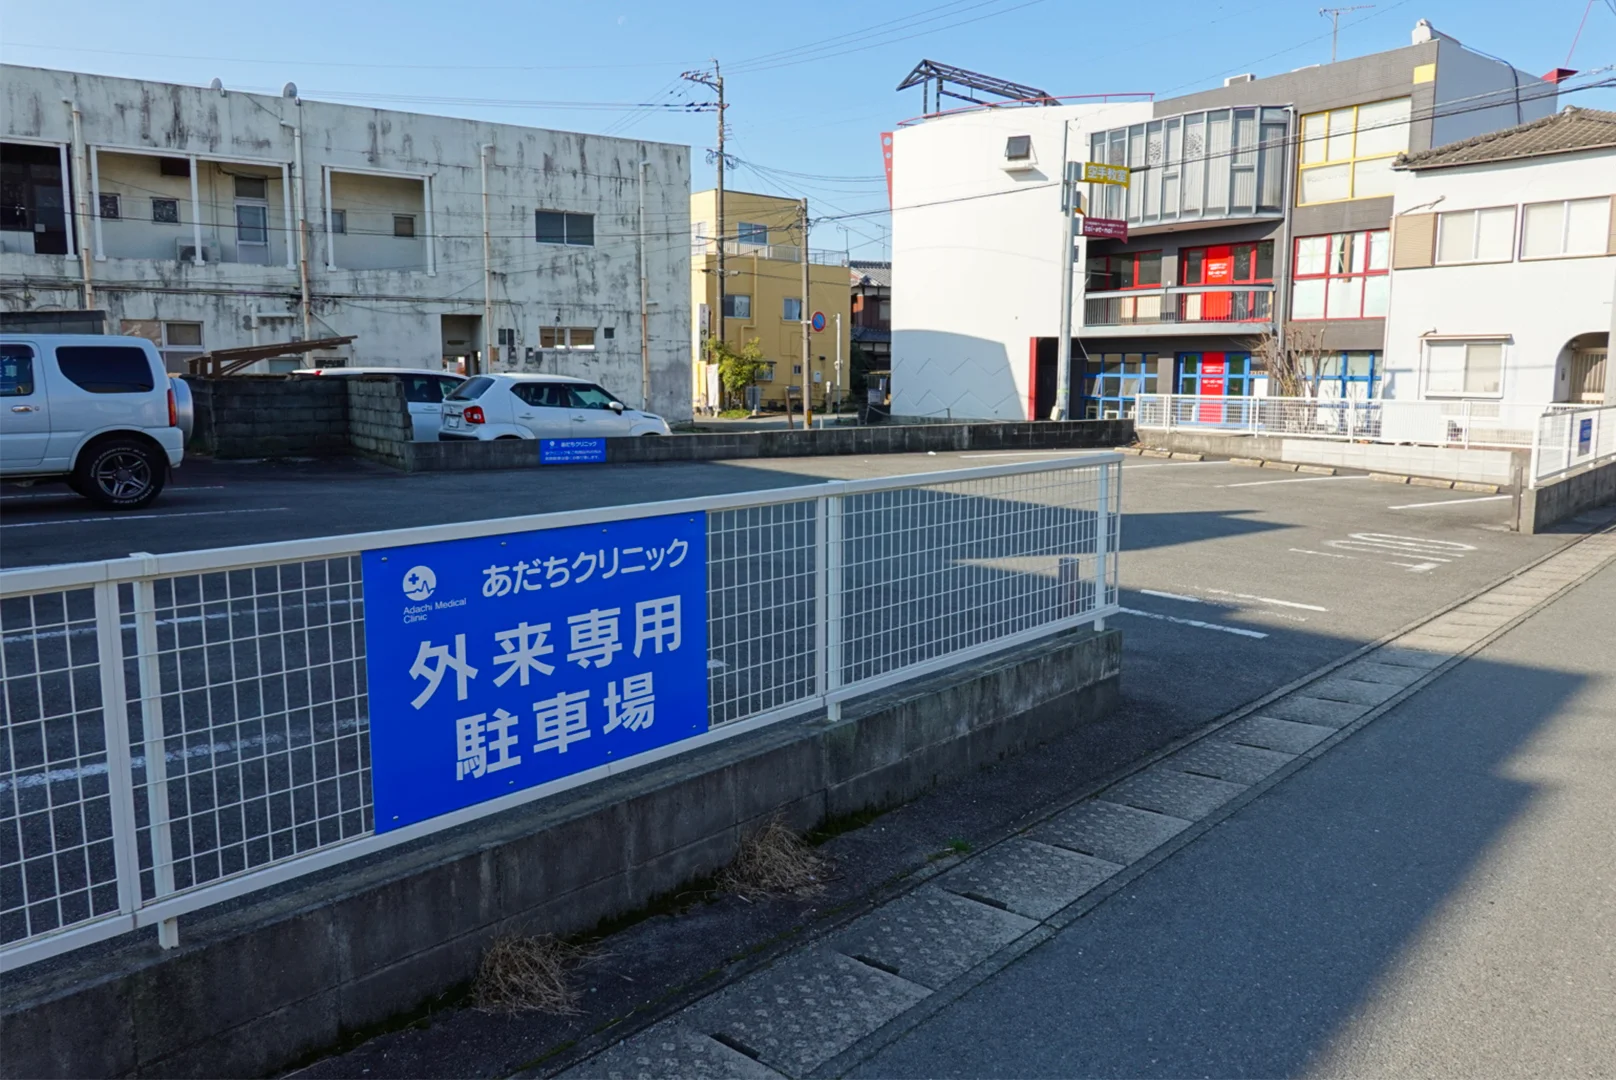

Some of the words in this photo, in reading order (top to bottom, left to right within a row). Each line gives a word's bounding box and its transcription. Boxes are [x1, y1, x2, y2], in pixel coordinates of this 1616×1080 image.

[1087, 165, 1127, 182] 空手教室
[482, 538, 688, 598] あだちクリニック
[403, 604, 433, 615] Adachi
[434, 598, 467, 610] Medical
[403, 613, 428, 624] Clinic
[408, 594, 682, 711] 外来専用
[455, 671, 655, 782] 駐車場
